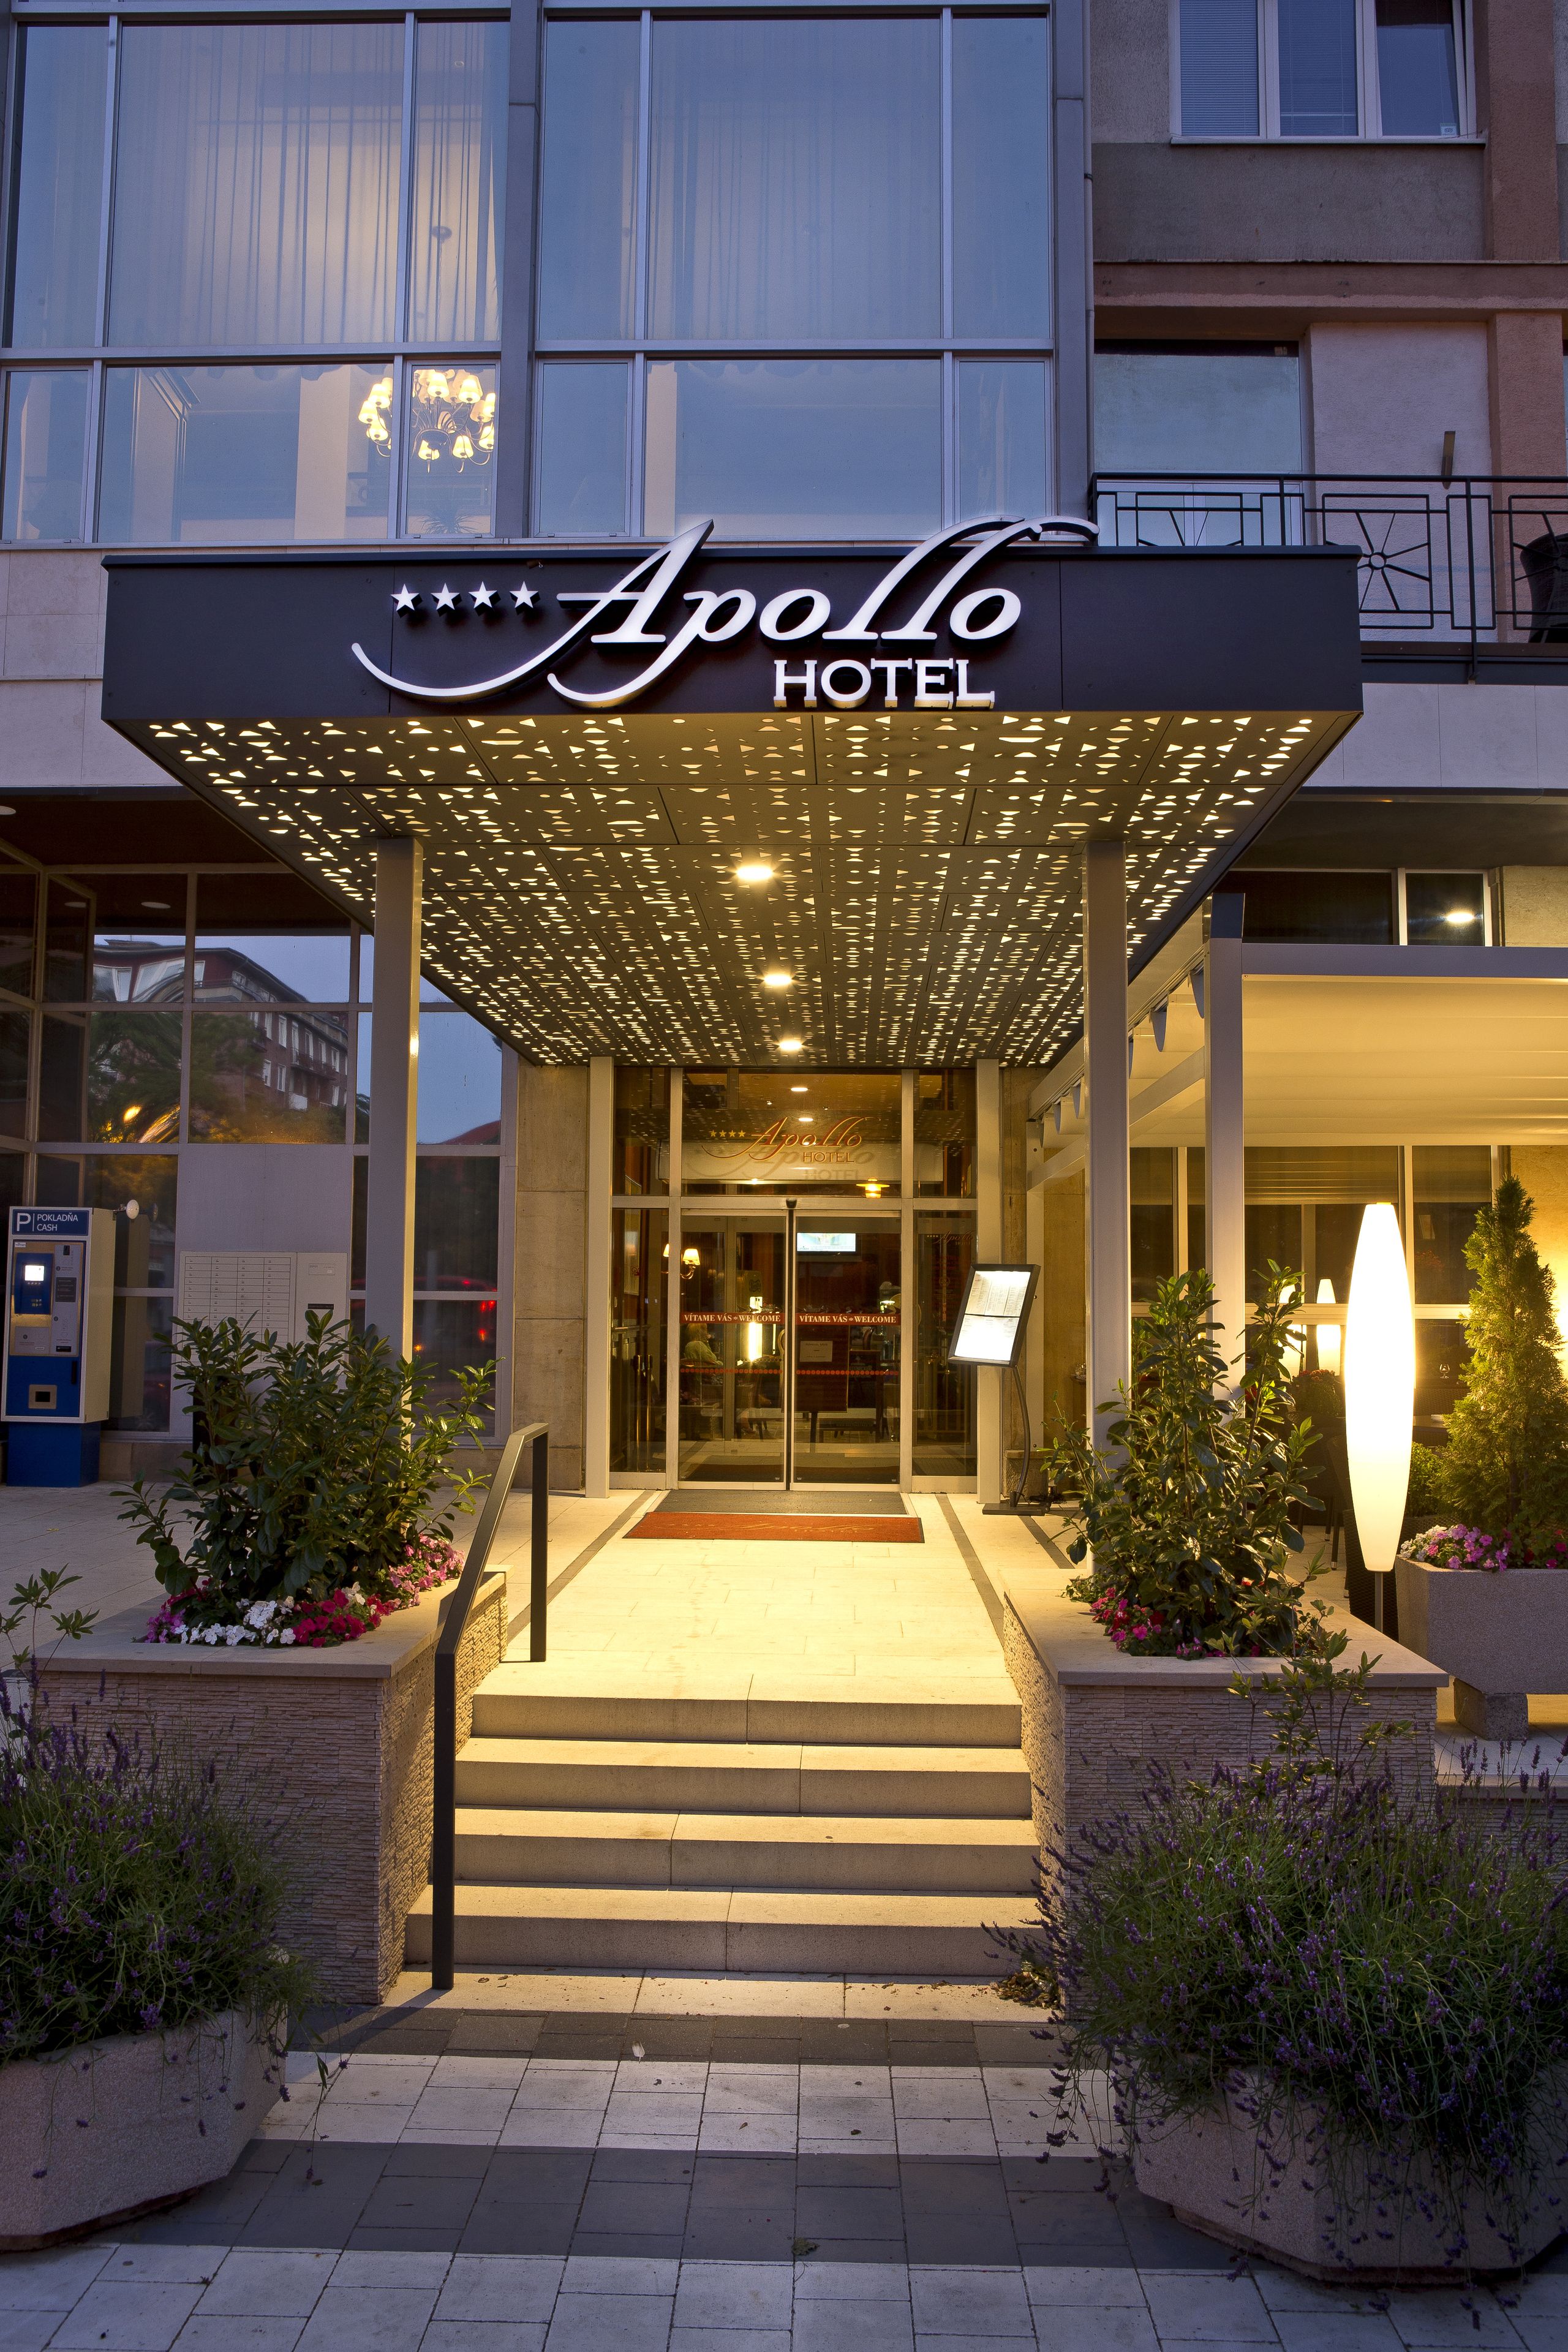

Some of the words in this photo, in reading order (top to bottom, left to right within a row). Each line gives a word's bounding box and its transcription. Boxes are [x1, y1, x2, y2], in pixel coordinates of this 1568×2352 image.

[352, 516, 1100, 708] Apollo
[773, 658, 995, 709] HOTEL
[701, 1116, 881, 1162] Apollo
[802, 1152, 855, 1163] HOTEL
[17, 1213, 31, 1232] P
[37, 1212, 78, 1222] POKLADŇA
[684, 1313, 715, 1322] VÍTAME
[717, 1313, 732, 1322] VÁS
[799, 1314, 831, 1323] VÍTAME
[832, 1314, 848, 1323] VÁS
